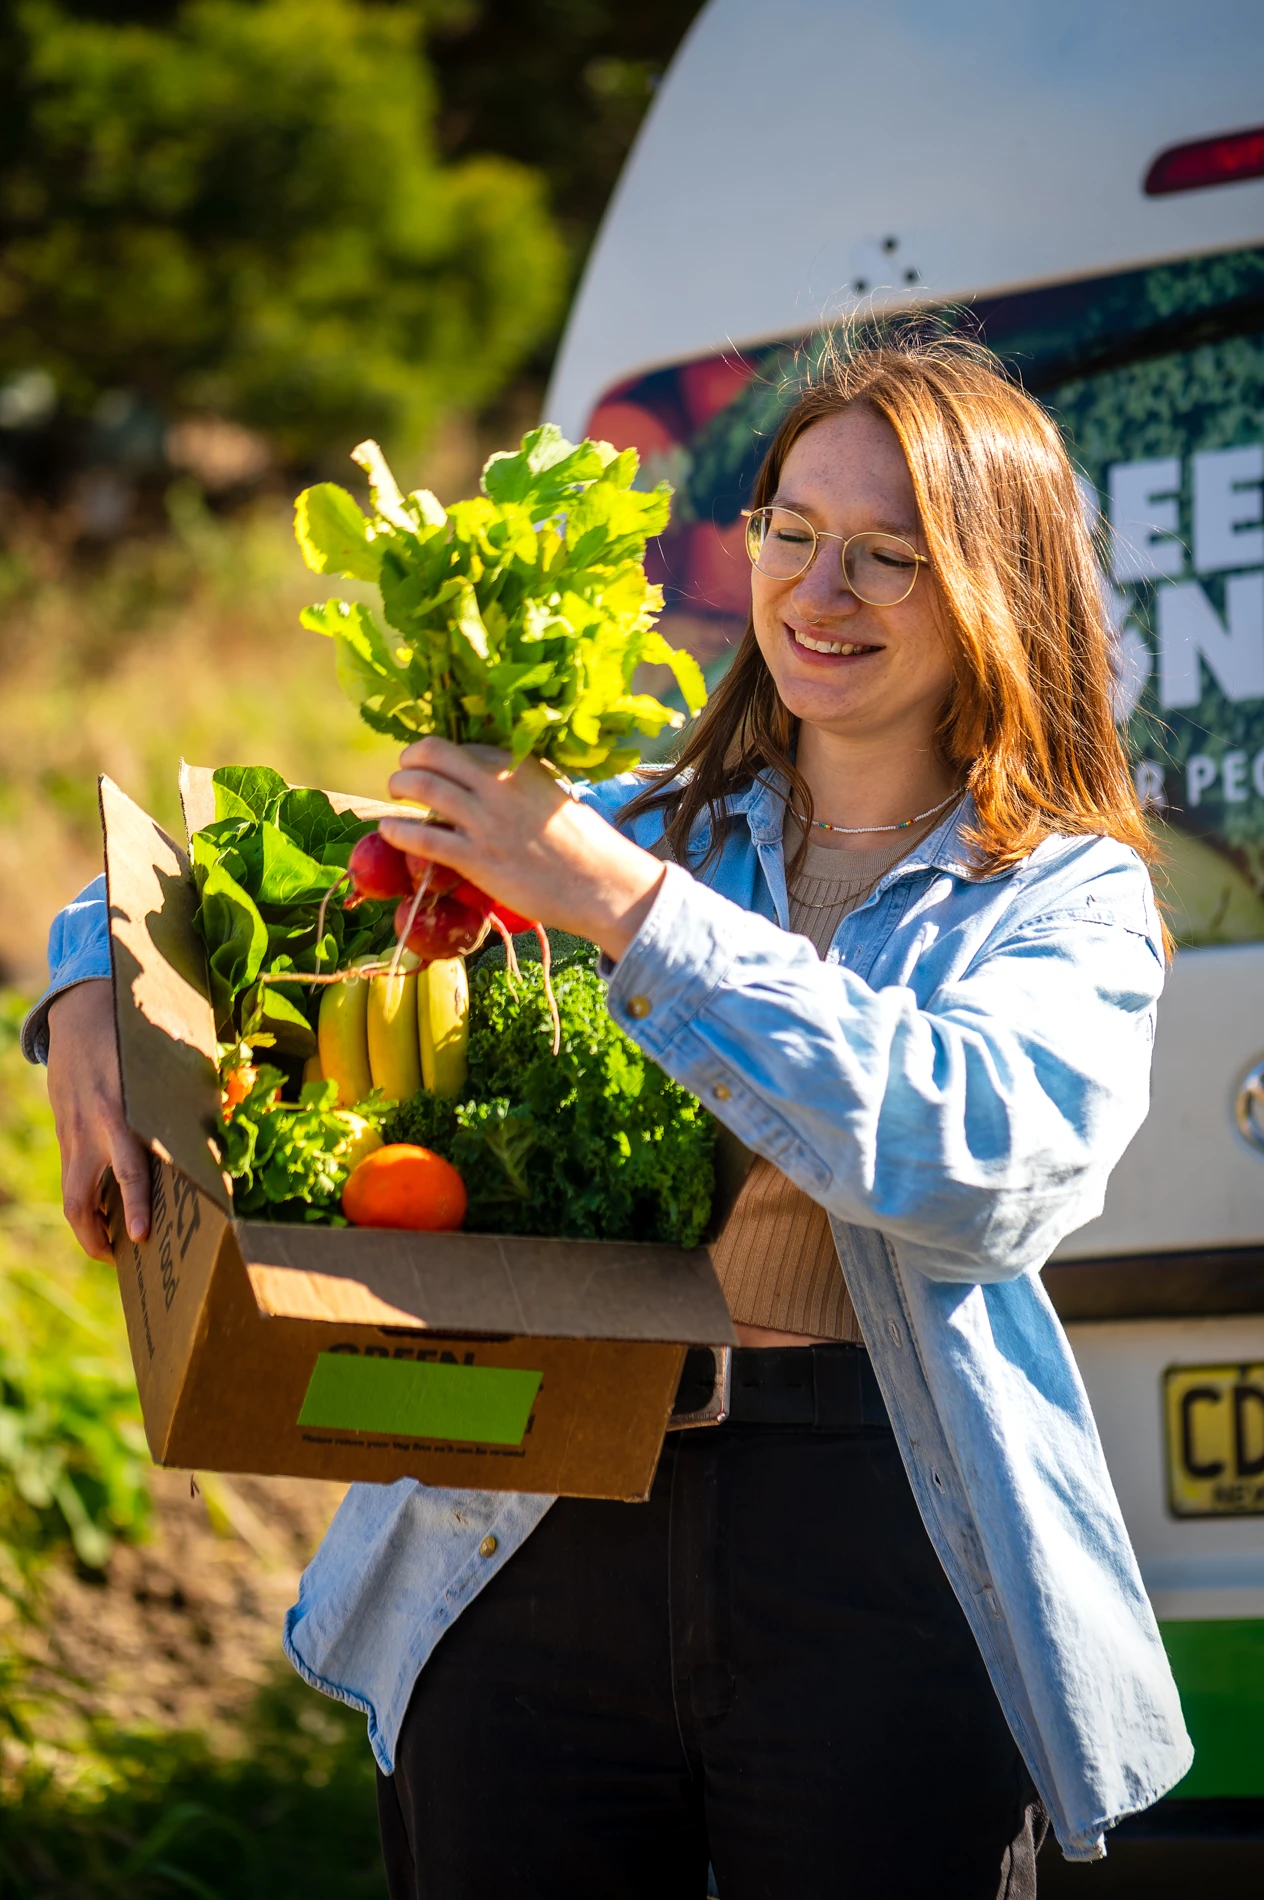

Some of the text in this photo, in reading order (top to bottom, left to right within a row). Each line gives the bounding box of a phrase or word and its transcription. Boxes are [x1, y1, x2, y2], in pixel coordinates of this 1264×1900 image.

[1080, 445, 1264, 583] EE
[159, 1220, 180, 1313] food
[1181, 1386, 1264, 1479] CD
